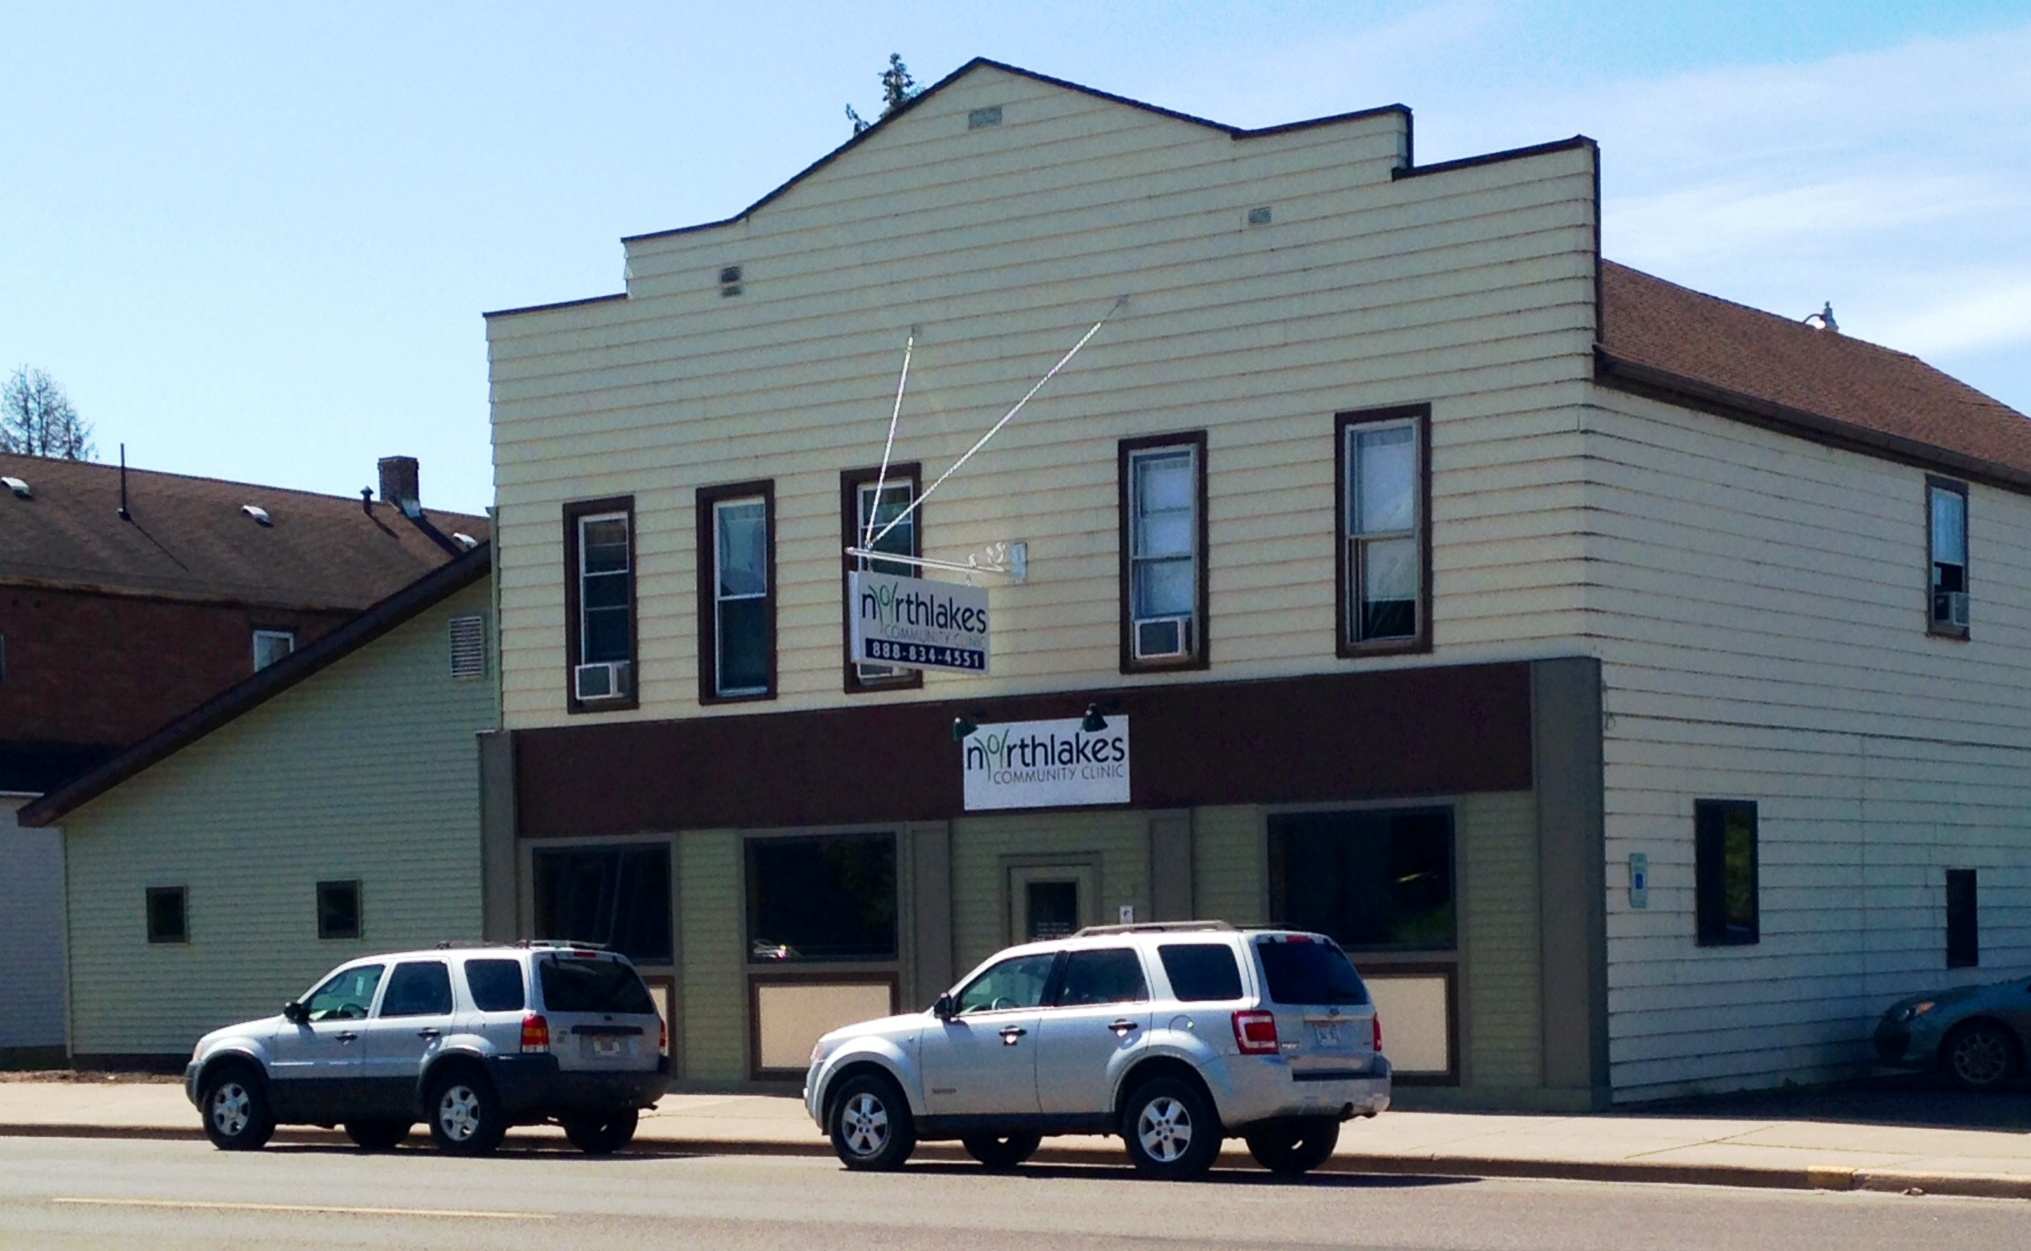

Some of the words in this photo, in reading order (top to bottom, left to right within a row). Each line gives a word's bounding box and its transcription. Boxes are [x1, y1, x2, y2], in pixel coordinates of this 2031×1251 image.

[862, 582, 987, 634] northlakes
[885, 624, 949, 645] COMMUNITY
[872, 641, 980, 667] 888-834-4551
[967, 728, 1126, 778] northlakes
[993, 766, 1077, 785] COMMUNITY
[1081, 764, 1124, 781] CLINIC
